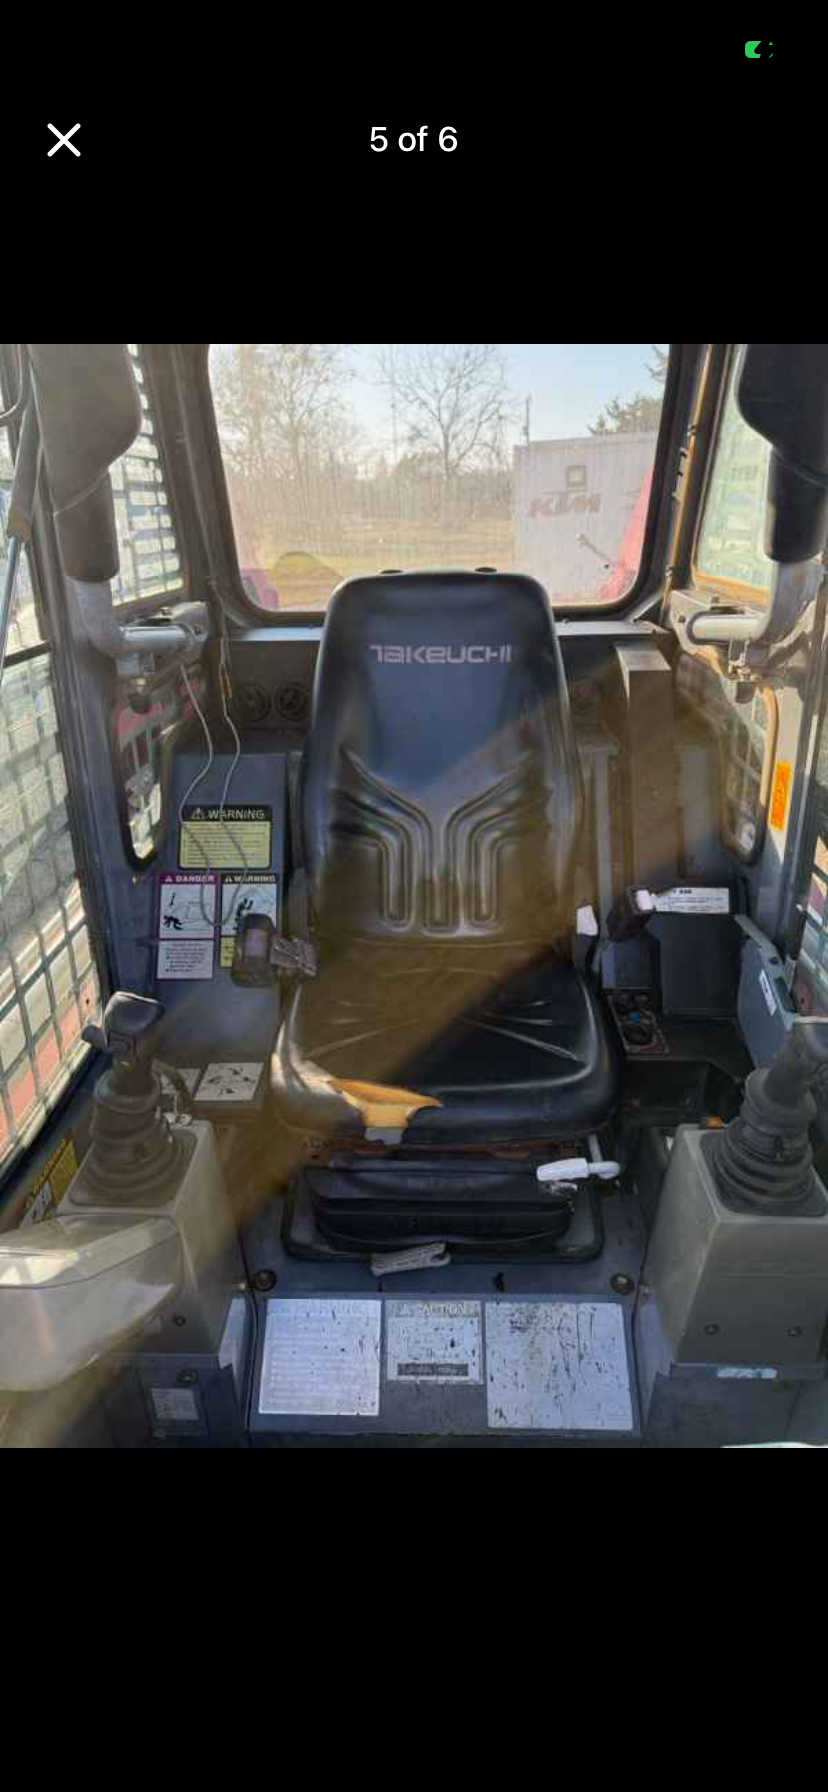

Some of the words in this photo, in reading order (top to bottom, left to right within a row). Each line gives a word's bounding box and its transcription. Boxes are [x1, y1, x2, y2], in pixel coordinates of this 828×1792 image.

[369, 644, 512, 664] TAKEUCHI
[207, 808, 266, 820] WARNING
[176, 875, 215, 883] DANGER
[234, 875, 276, 883] WARNING
